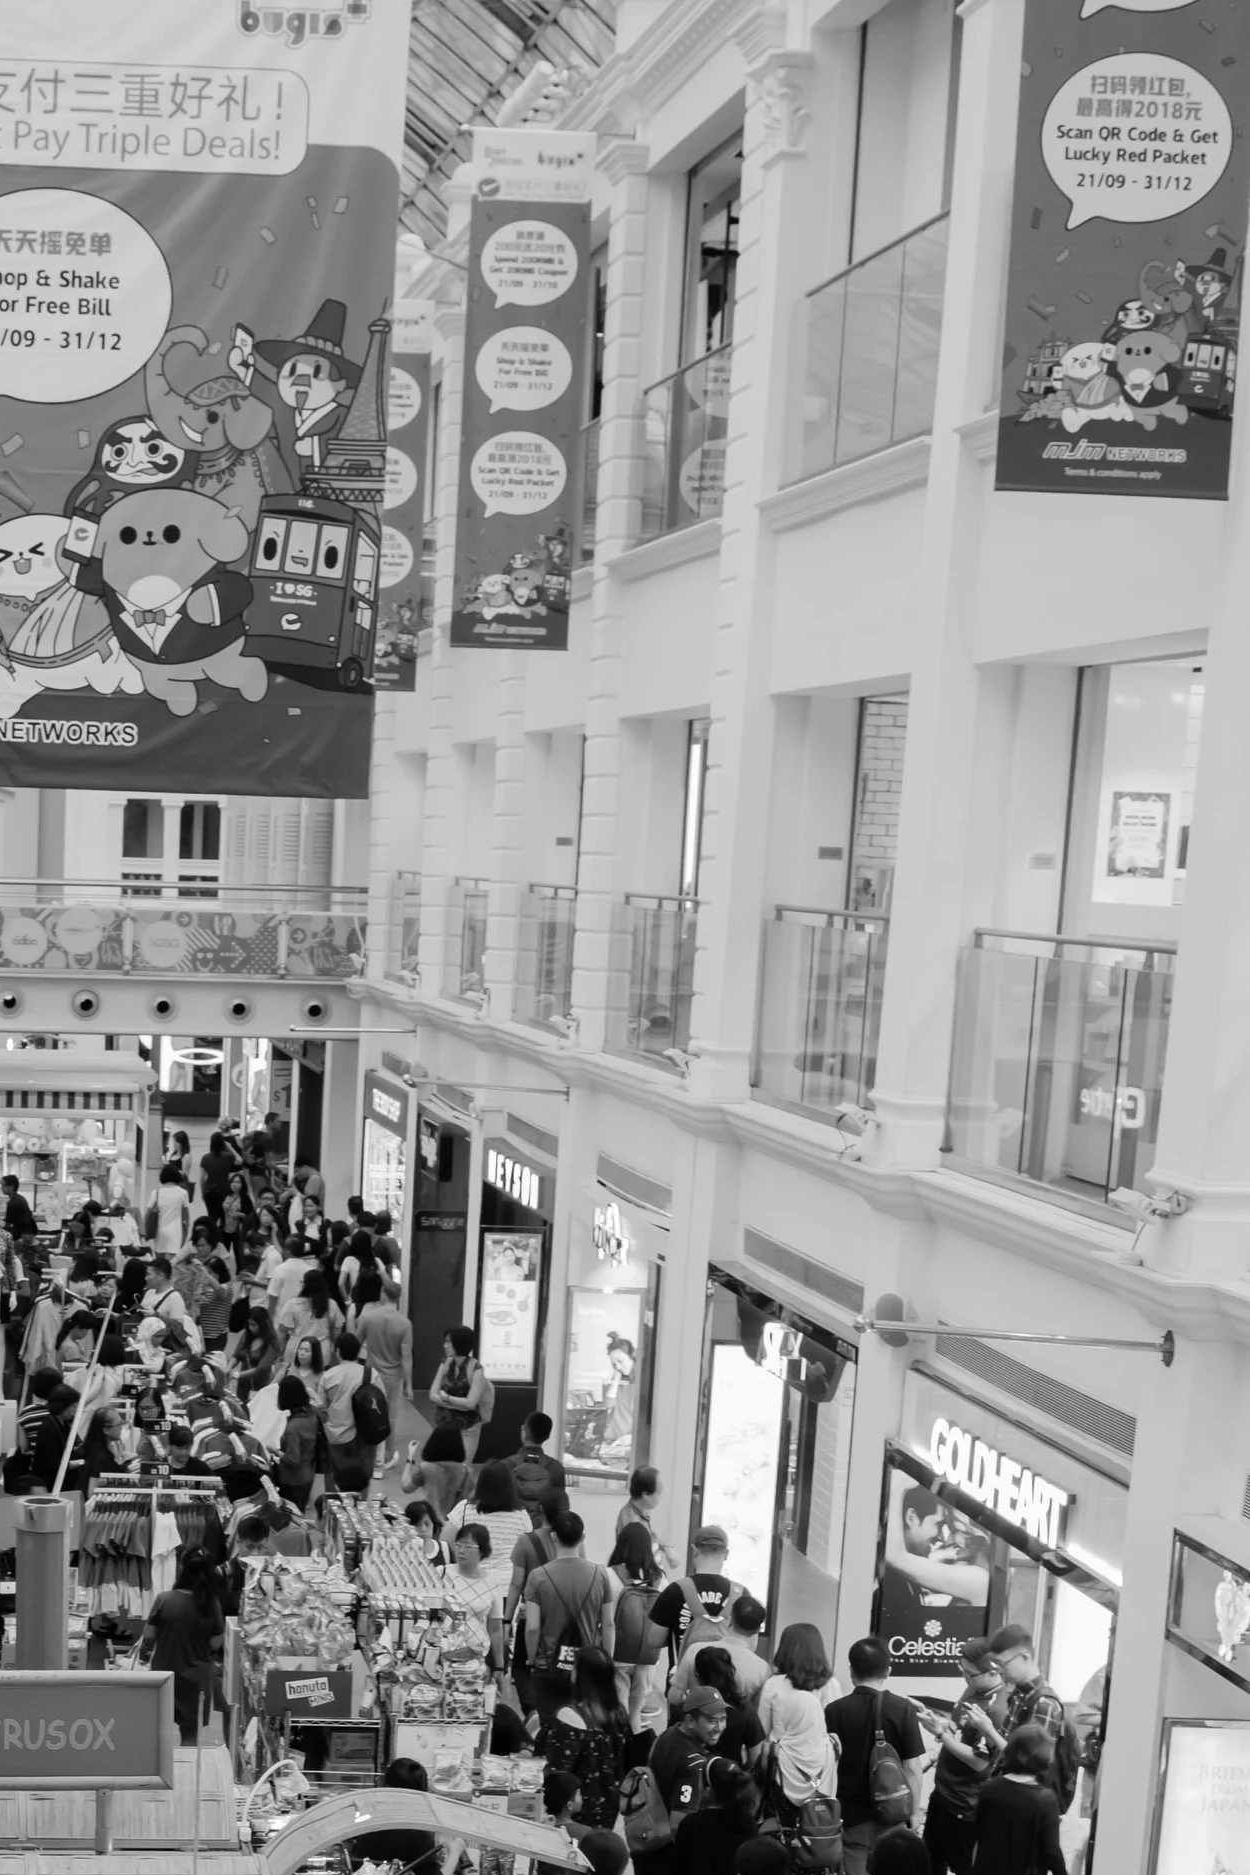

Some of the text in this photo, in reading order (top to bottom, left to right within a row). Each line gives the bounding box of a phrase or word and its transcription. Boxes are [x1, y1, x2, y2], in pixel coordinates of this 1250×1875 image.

[14, 120, 70, 160] Pay
[78, 122, 171, 163] Triple
[182, 127, 281, 161] Deals!
[1056, 125, 1219, 144] Scan QR Code & Get
[1064, 146, 1207, 165] Lucky Red Packet
[1076, 173, 1192, 191] 21/09 31/12
[36, 269, 51, 287] &
[59, 270, 120, 289] Shake
[25, 296, 70, 315] Free
[78, 298, 112, 316] Bill
[60, 331, 121, 350] 31/12
[1106, 446, 1187, 463] NETWORKS
[930, 1417, 1069, 1550] GOLDHEART
[888, 1635, 970, 1657] Celestia
[680, 1785, 693, 1803] 3
